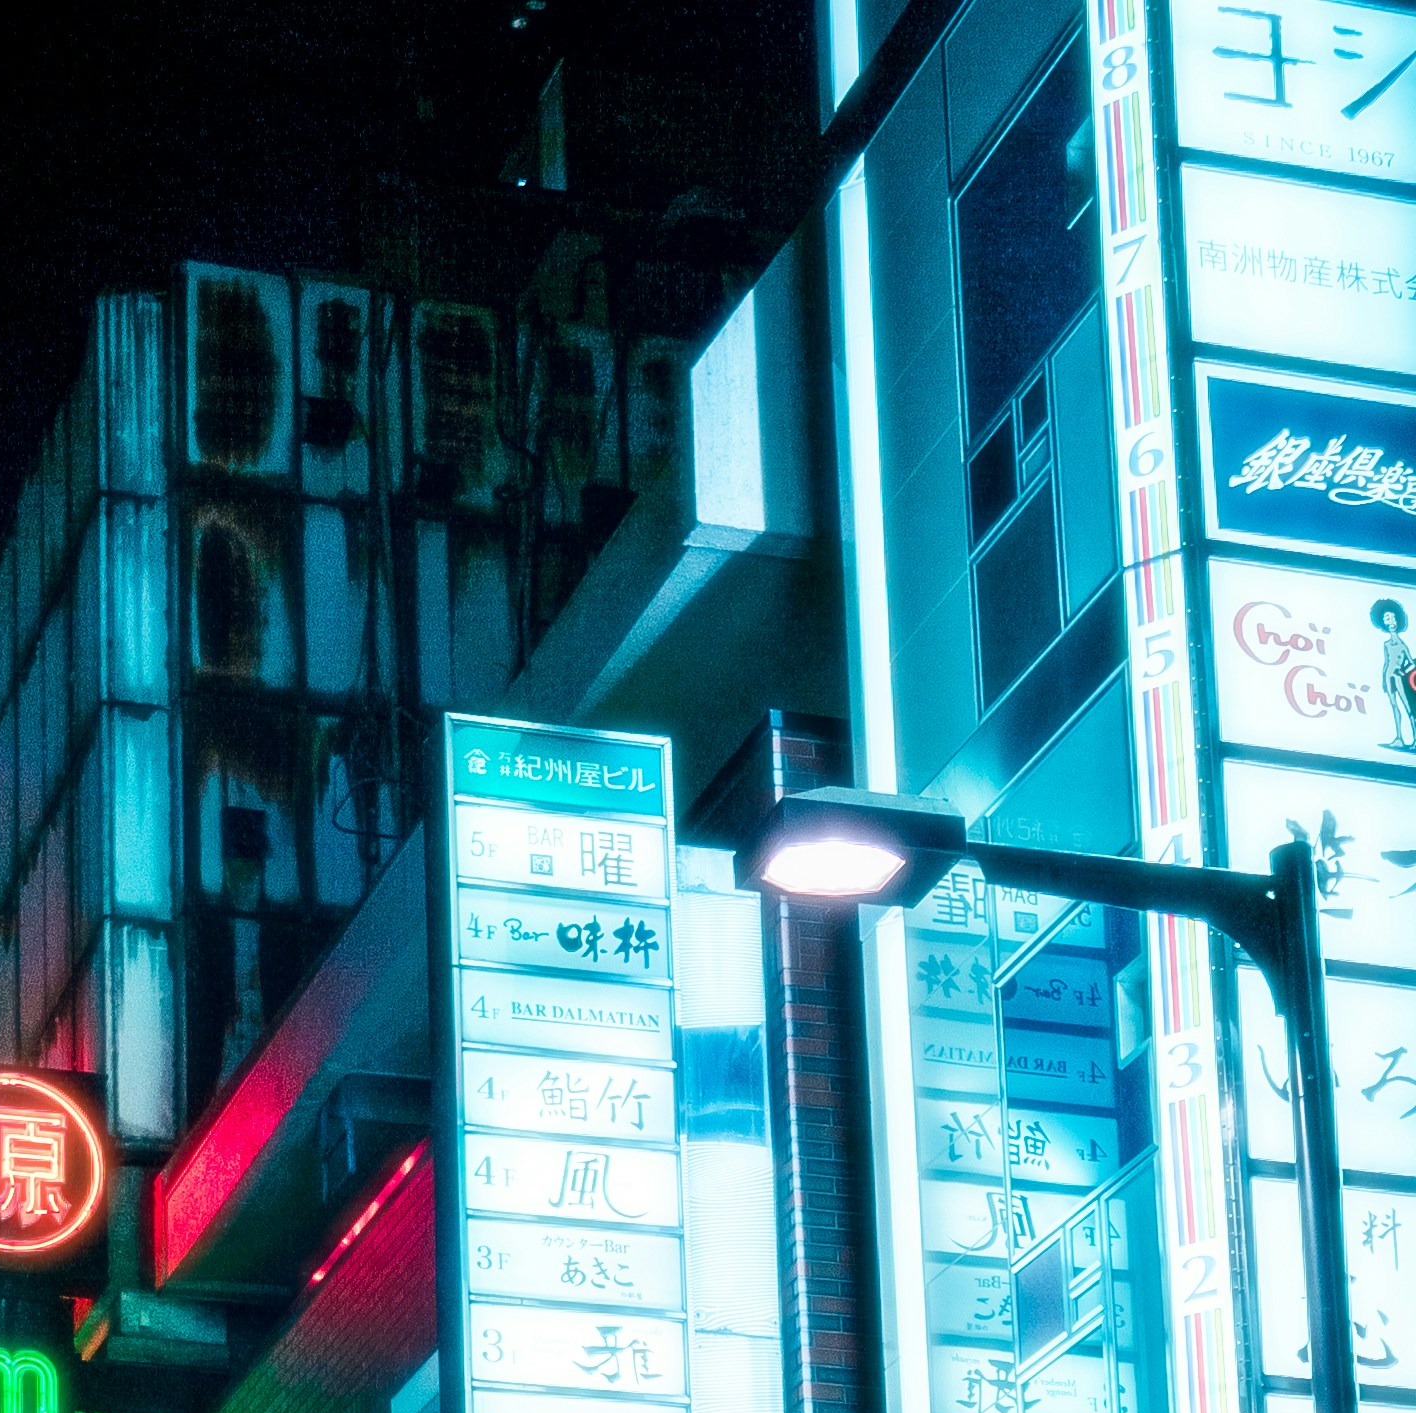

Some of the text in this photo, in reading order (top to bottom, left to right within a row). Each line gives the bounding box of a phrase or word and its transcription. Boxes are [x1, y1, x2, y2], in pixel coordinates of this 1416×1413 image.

[1102, 46, 1137, 91] 8
[1242, 131, 1396, 169] SINCE 1967
[1112, 235, 1147, 287] 7
[1128, 431, 1164, 480] 6
[1142, 631, 1175, 679] 5
[513, 755, 657, 793] 紀州屋ビル
[527, 825, 564, 848] BAR
[579, 831, 639, 888] 曜
[466, 911, 550, 943] 4F Bar
[470, 995, 661, 1028] 4F BAR DALMATIAN
[1168, 1042, 1204, 1089] 3
[537, 1069, 652, 1132] 鮨竹
[547, 1150, 649, 1219] 風
[476, 1245, 511, 1271] 3F
[560, 1254, 635, 1289] あきこ
[1182, 1254, 1219, 1300] 2
